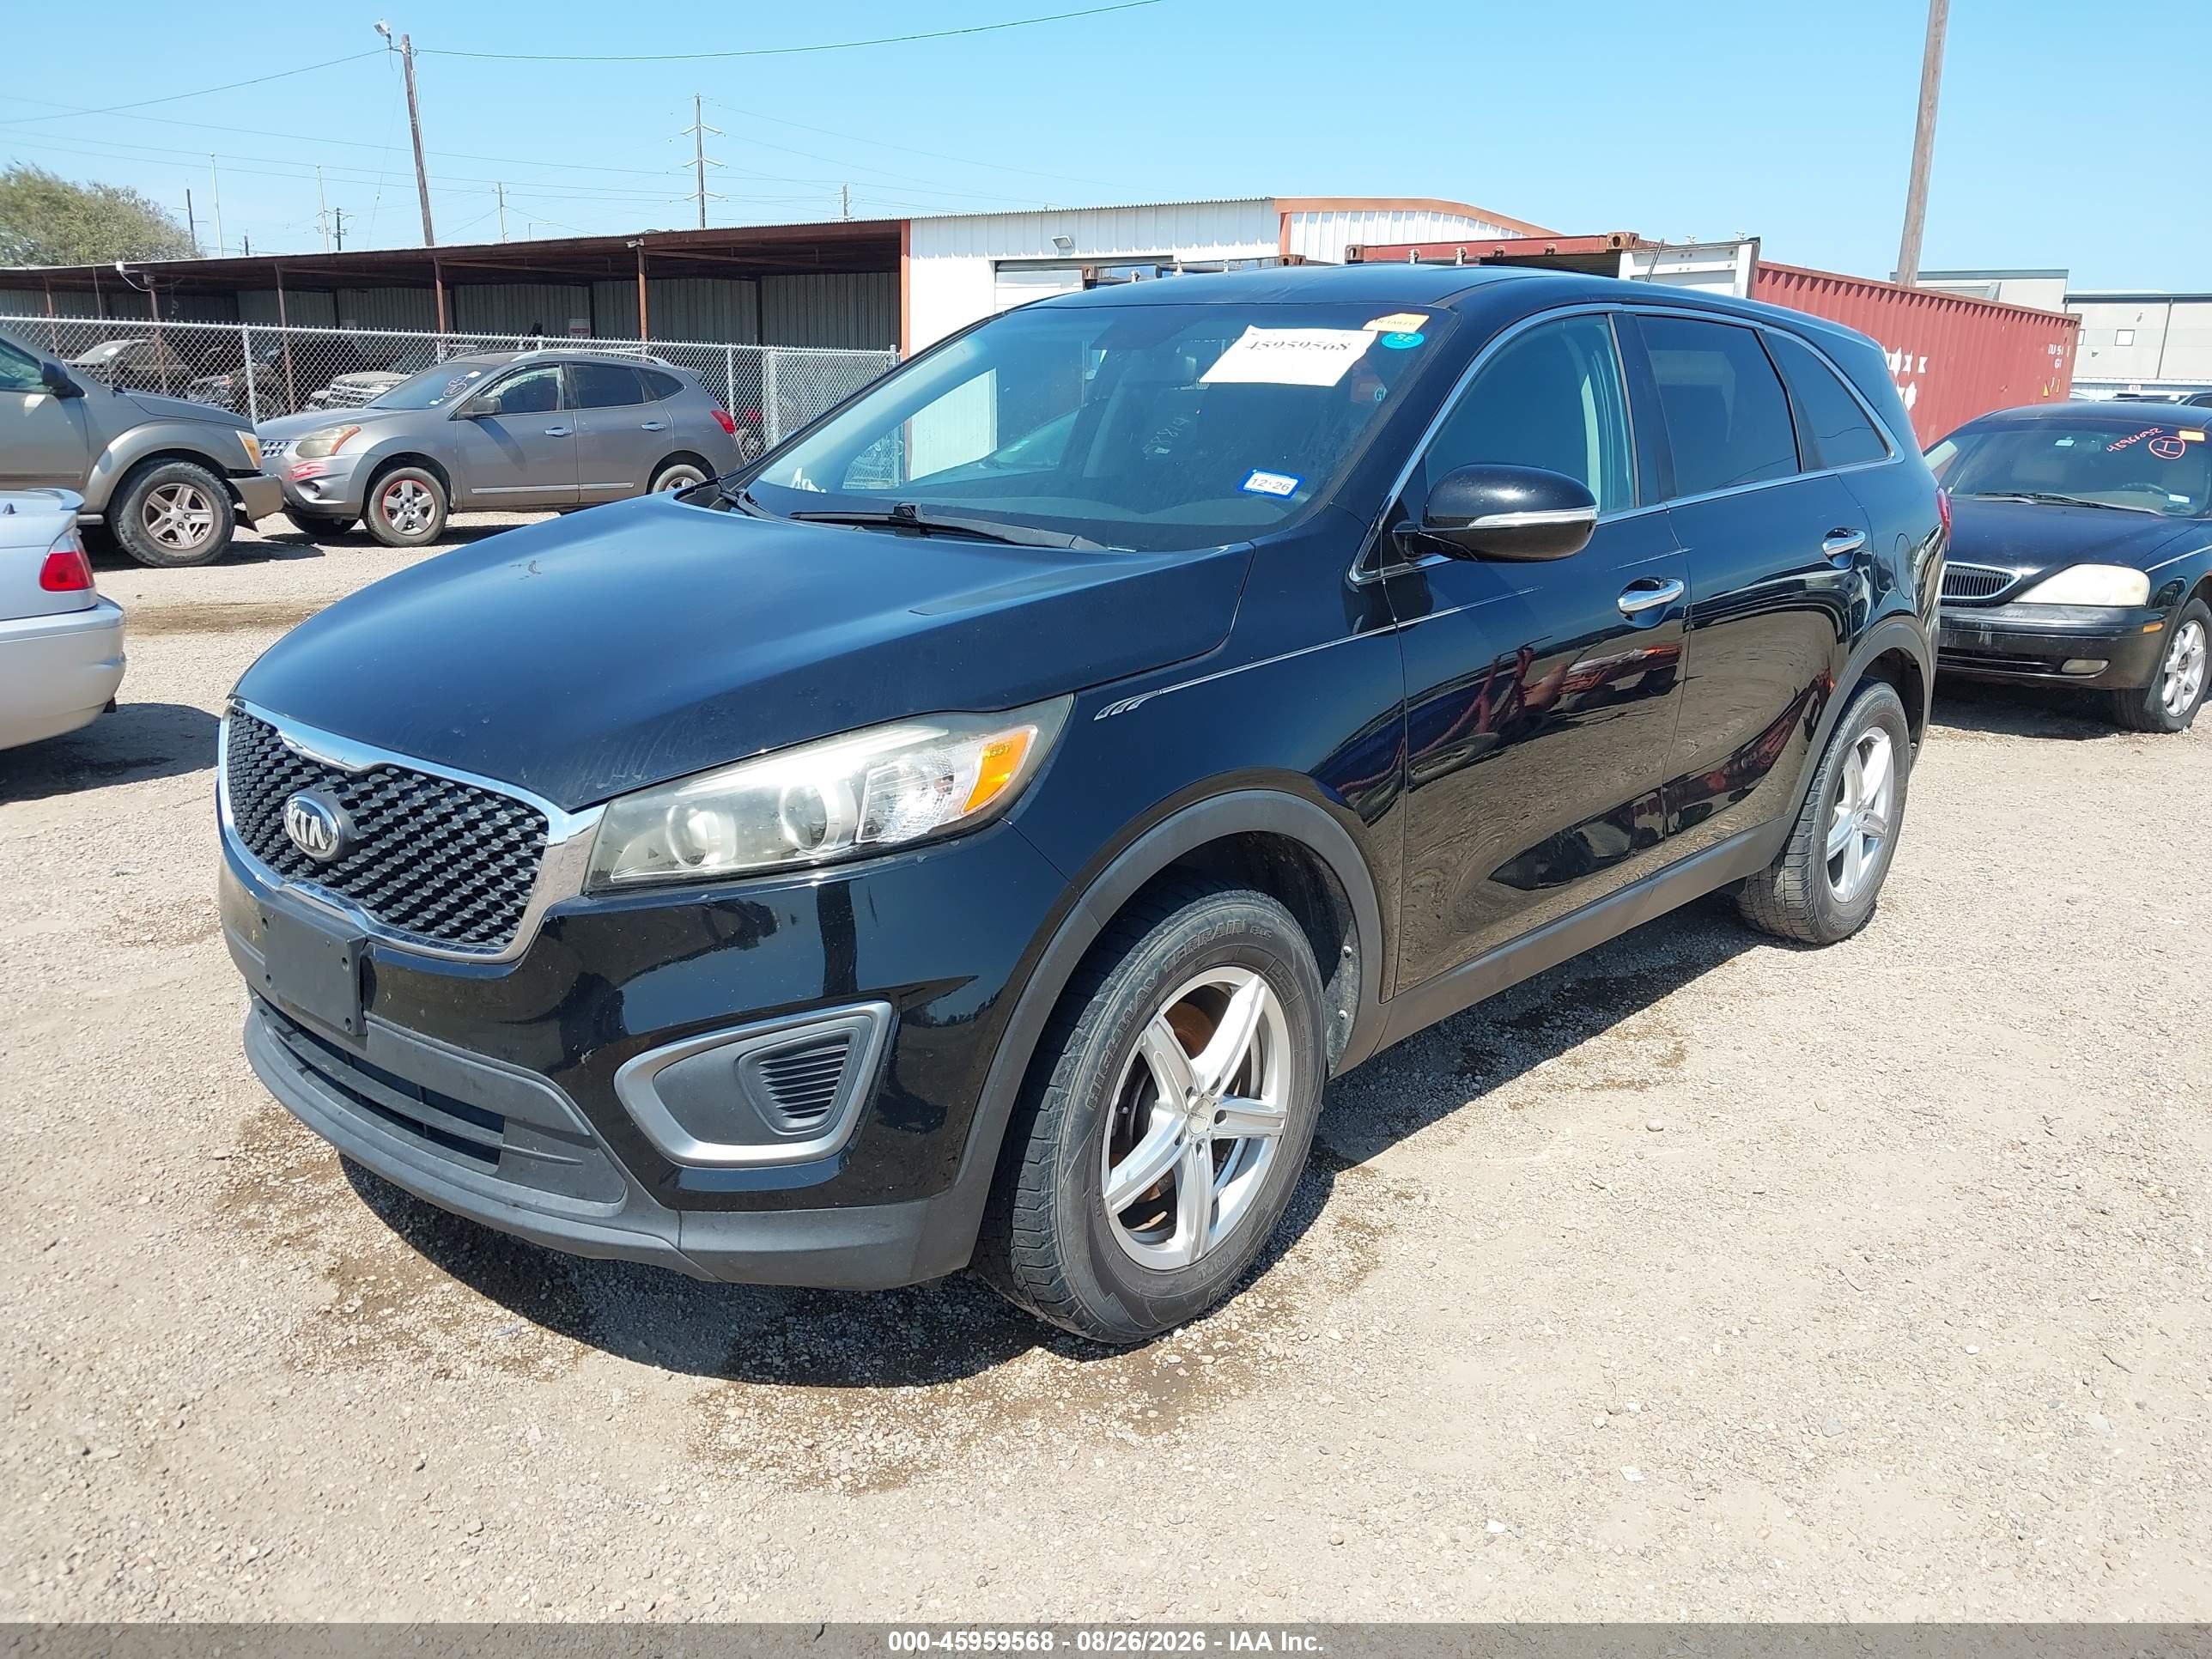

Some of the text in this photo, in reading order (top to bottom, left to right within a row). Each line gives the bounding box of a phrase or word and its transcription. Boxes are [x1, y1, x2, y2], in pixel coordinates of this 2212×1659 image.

[287, 801, 327, 850] KIA
[1085, 968, 1160, 1110] HIGHWAY
[1161, 920, 1246, 974] TERRAIN
